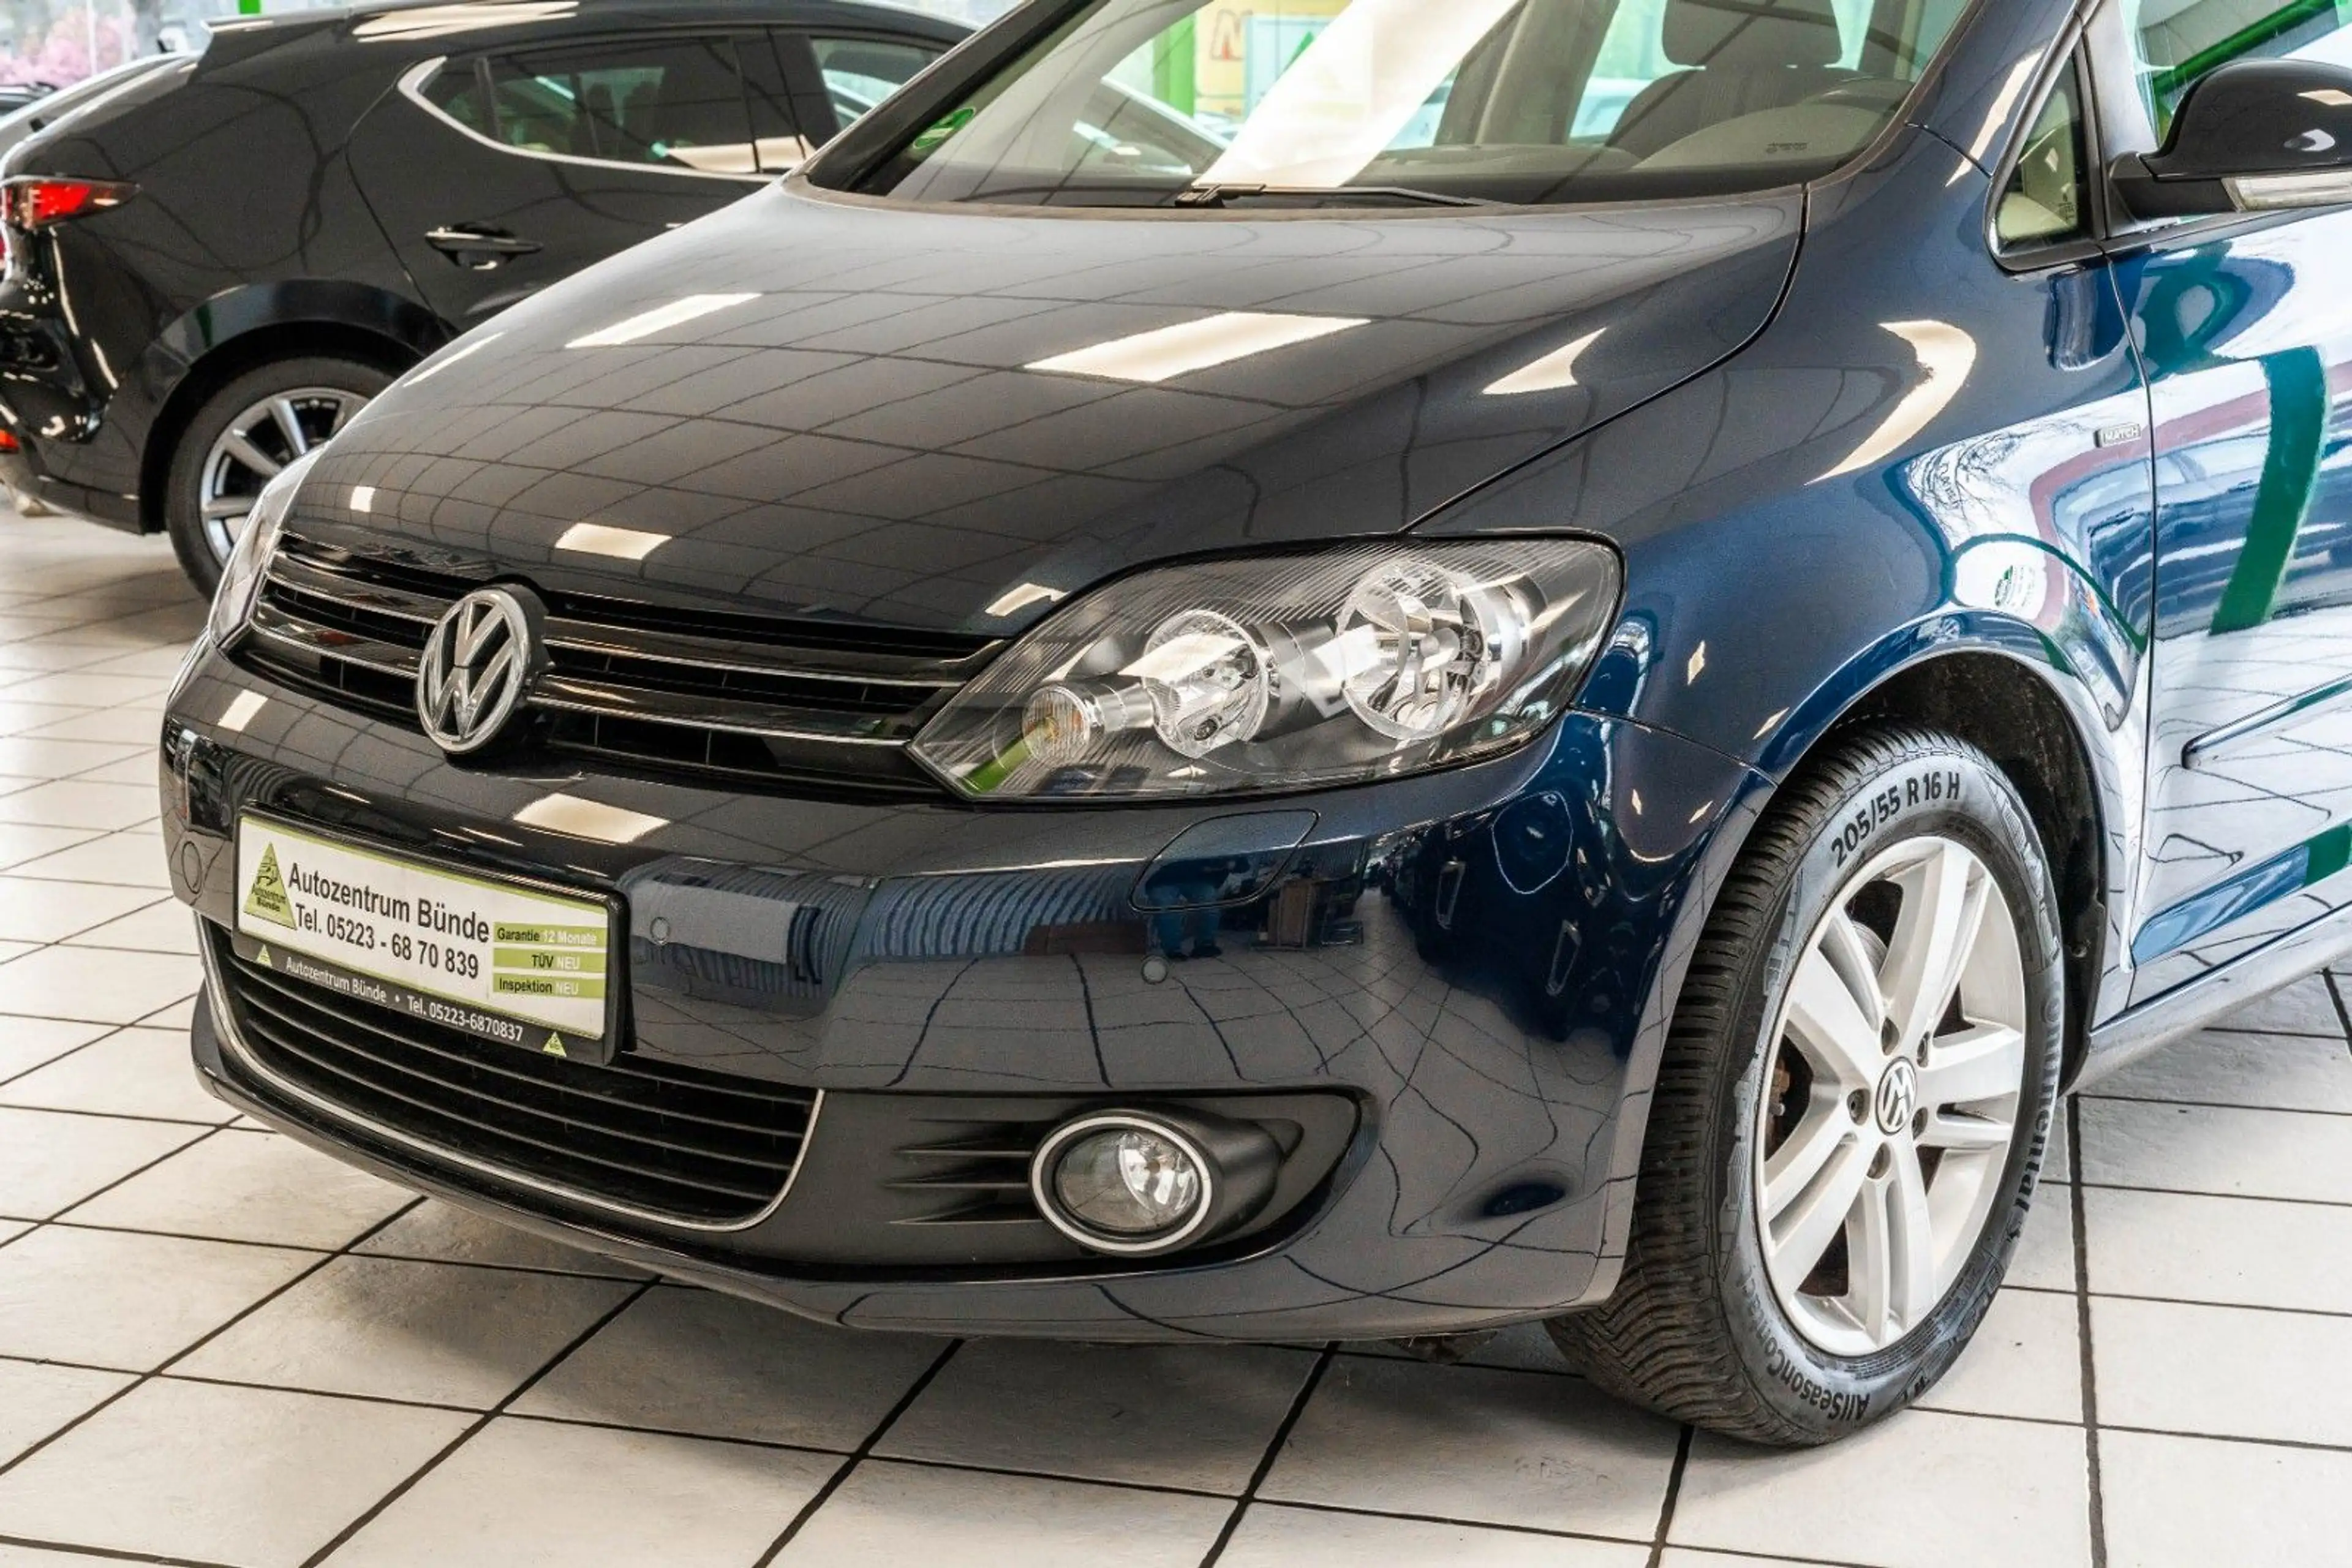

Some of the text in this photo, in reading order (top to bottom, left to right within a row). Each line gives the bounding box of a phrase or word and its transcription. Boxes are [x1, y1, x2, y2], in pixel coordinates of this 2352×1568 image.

[1831, 771, 1960, 869] 205/55 R 16 H
[288, 862, 489, 943] Autozentrum Bünde
[295, 902, 322, 934] Tel.
[327, 913, 375, 950] 05223
[391, 933, 412, 960] 68
[418, 940, 439, 968] 70
[445, 948, 479, 979] 839
[497, 927, 597, 946] Garantie 12 Monate
[286, 956, 523, 1042] Autozentrum Bünde Tel. 05223-6870837
[499, 978, 579, 995] Inspektion NEU
[532, 952, 580, 970] TÜV NEU
